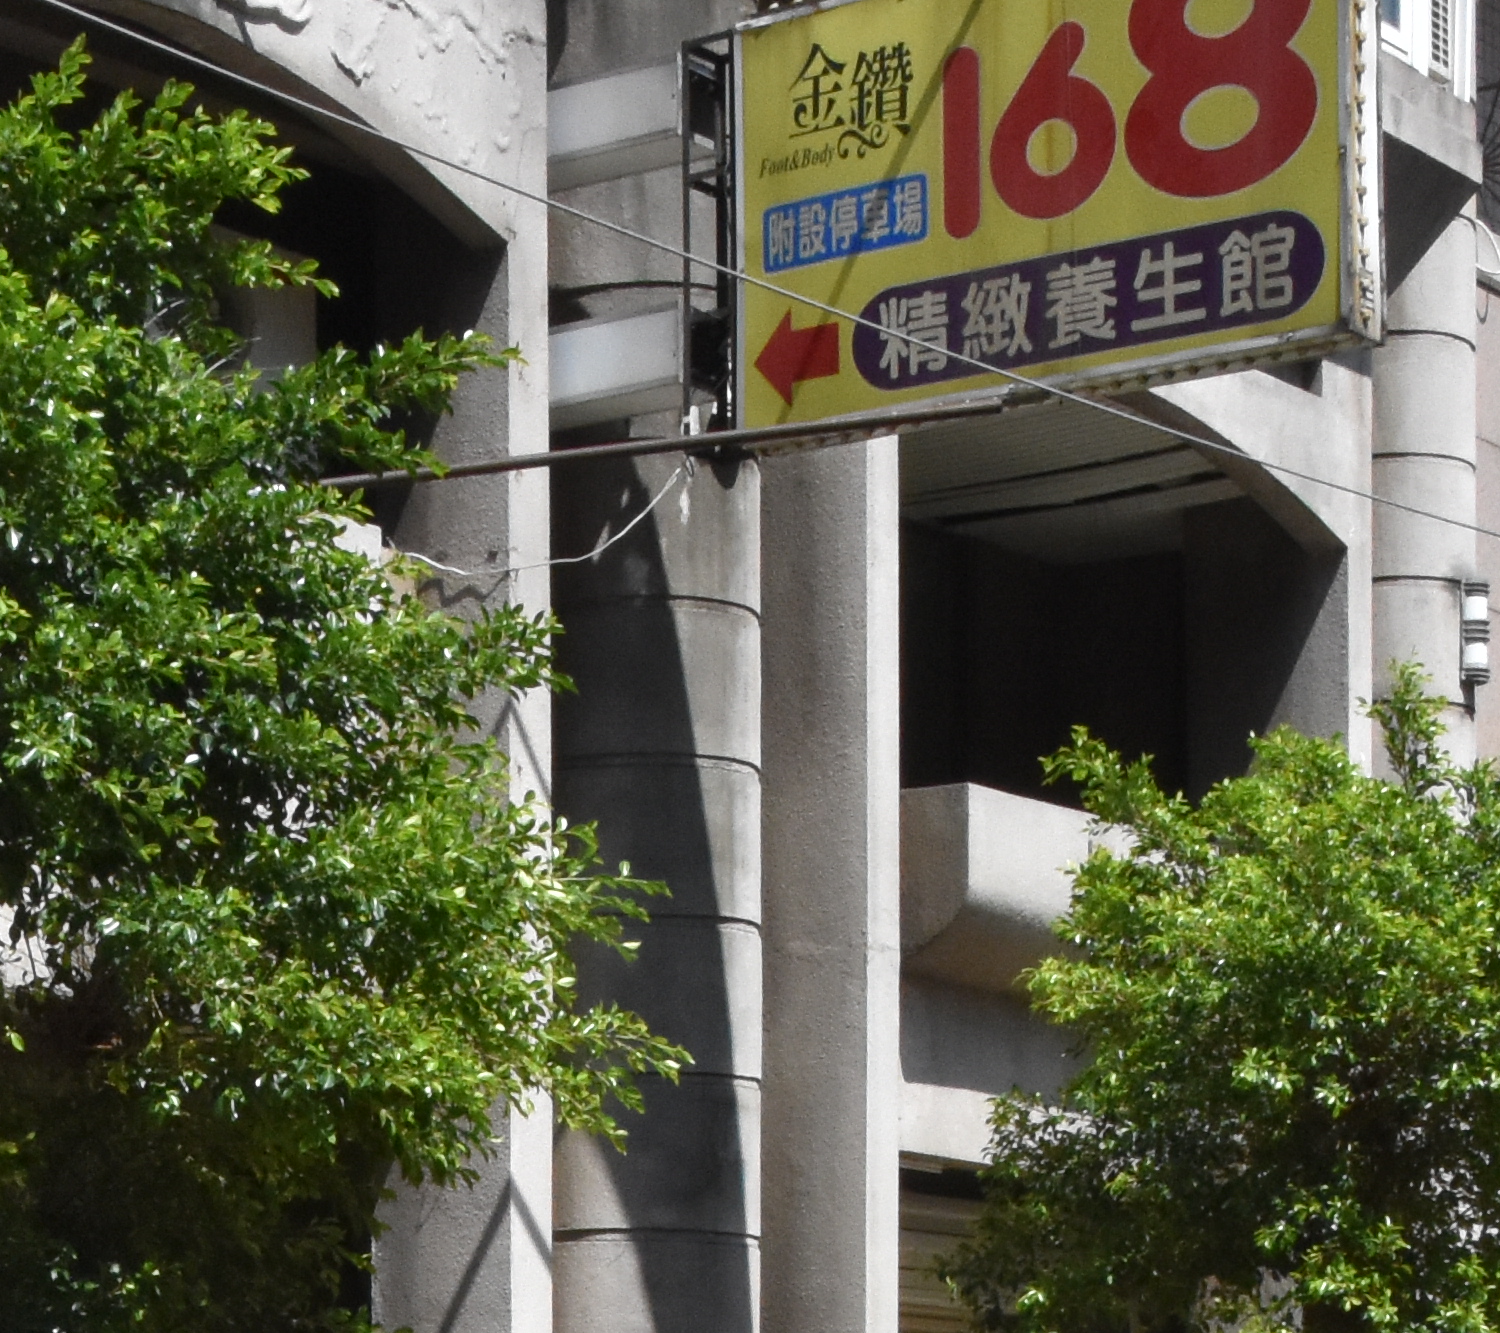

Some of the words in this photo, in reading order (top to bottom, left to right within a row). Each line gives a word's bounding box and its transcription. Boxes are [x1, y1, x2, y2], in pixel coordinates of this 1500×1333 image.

[789, 41, 914, 139] 金鑽
[942, 0, 1318, 239] 168
[769, 180, 923, 266] 附設停車場
[878, 223, 1296, 380] 精緻養生館
